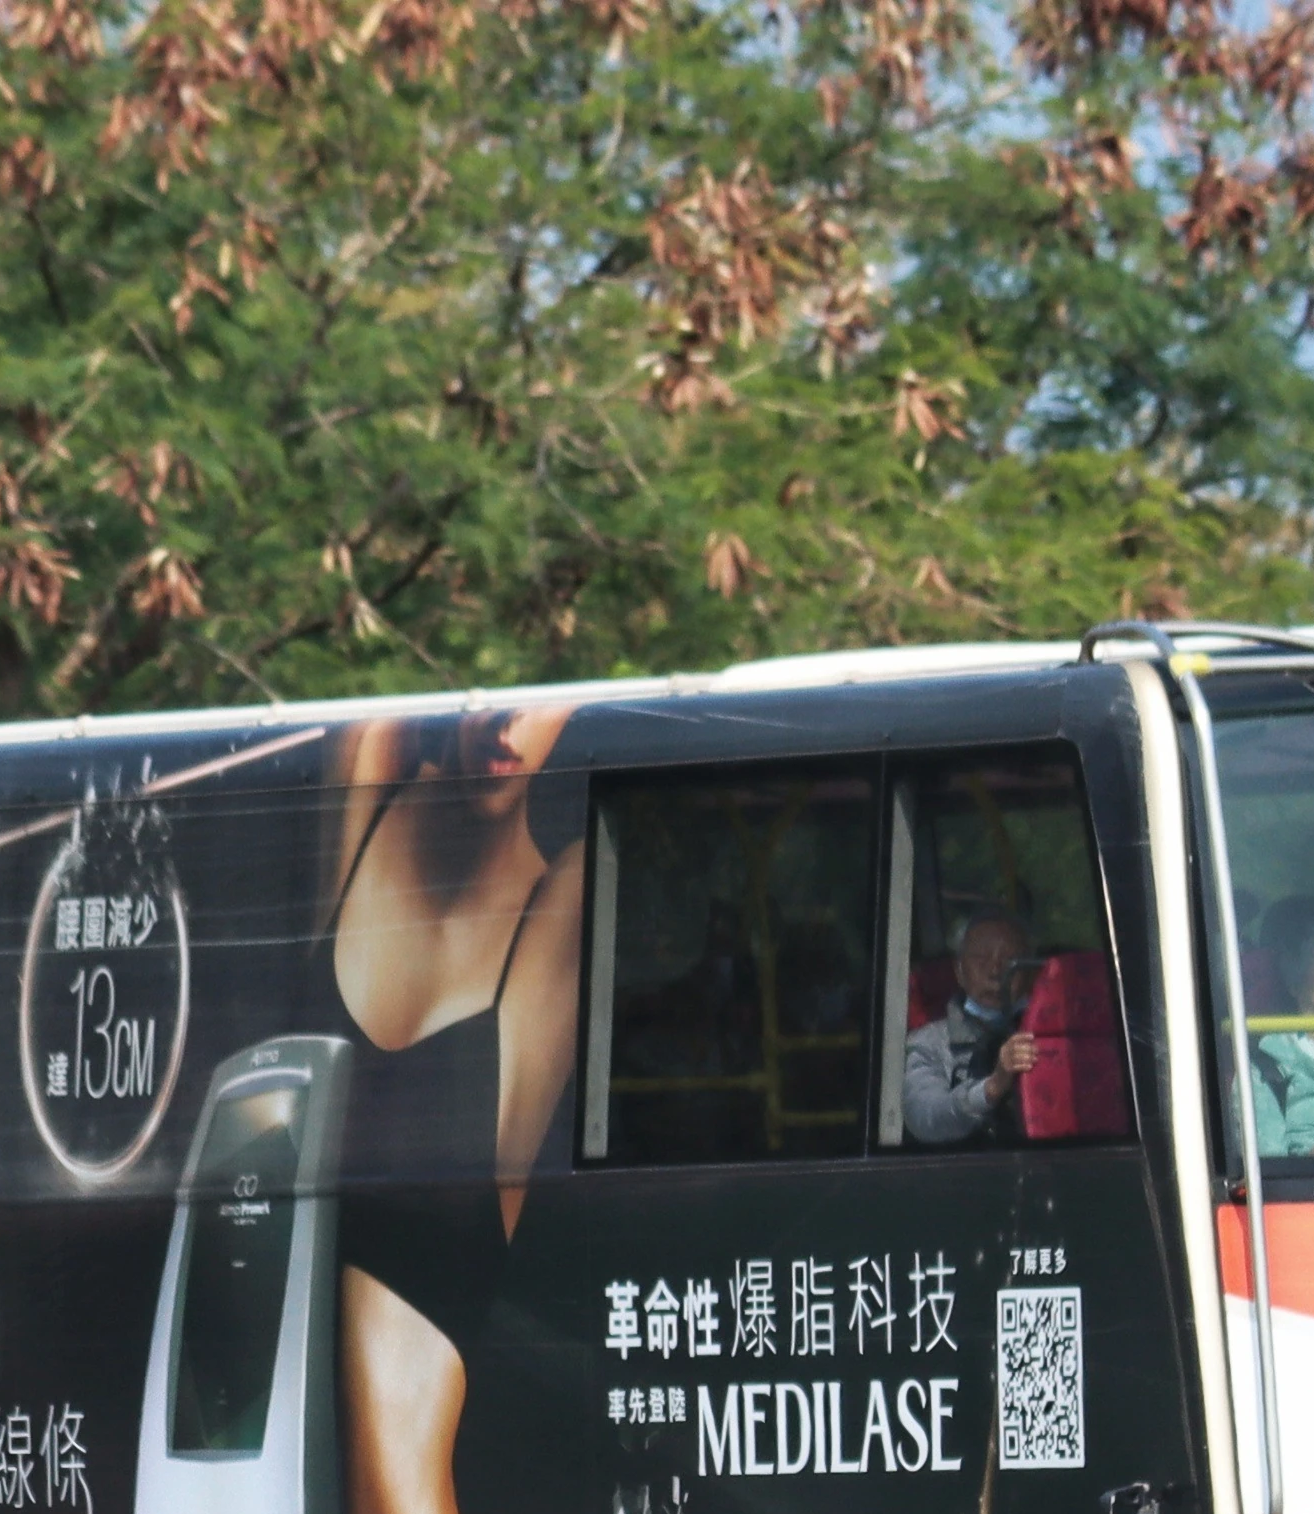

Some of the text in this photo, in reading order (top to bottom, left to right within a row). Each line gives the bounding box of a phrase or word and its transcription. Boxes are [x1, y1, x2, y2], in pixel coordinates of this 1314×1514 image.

[1010, 1248, 1067, 1275] 了解更多
[608, 1378, 962, 1477] 率先登陸 MEDILASE
